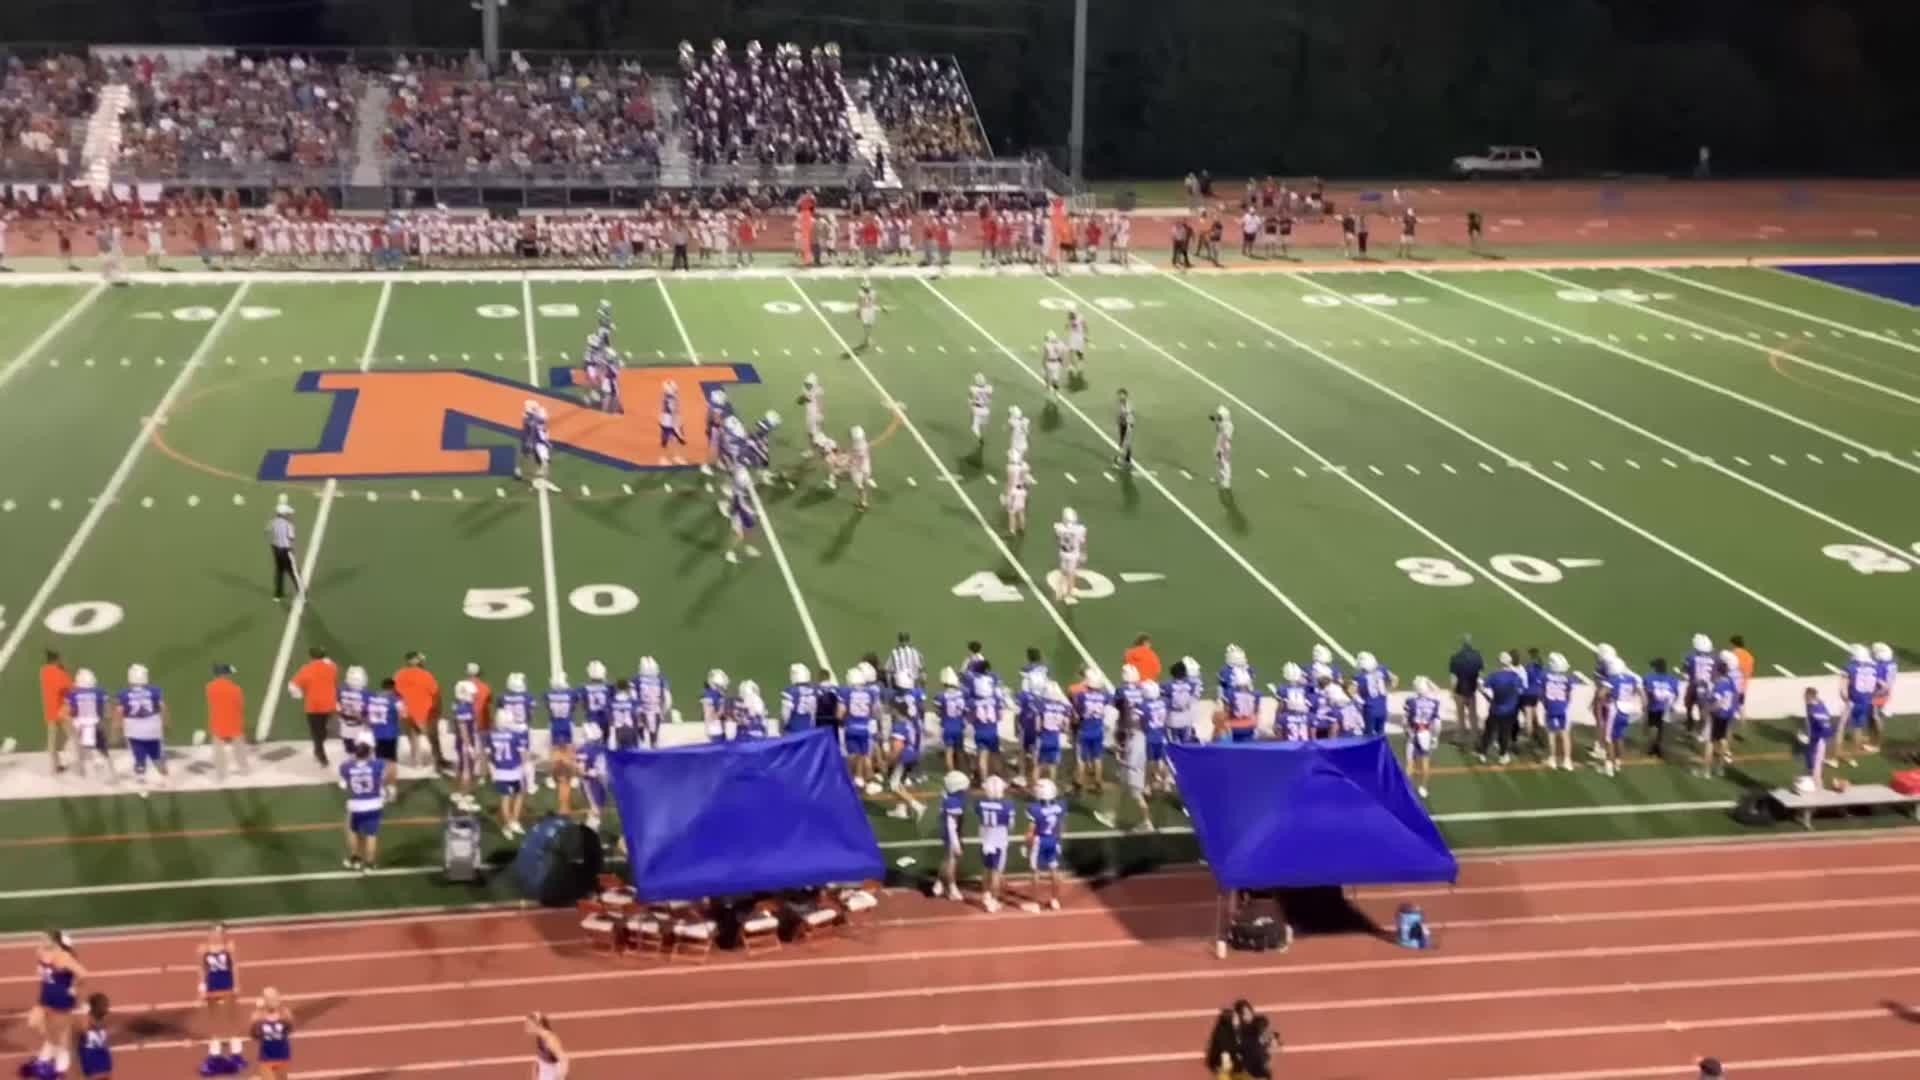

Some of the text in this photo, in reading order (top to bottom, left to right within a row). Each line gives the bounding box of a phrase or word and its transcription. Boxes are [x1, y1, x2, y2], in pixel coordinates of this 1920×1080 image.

[257, 362, 762, 481] N
[462, 585, 640, 620] 50
[952, 570, 1116, 602] 40
